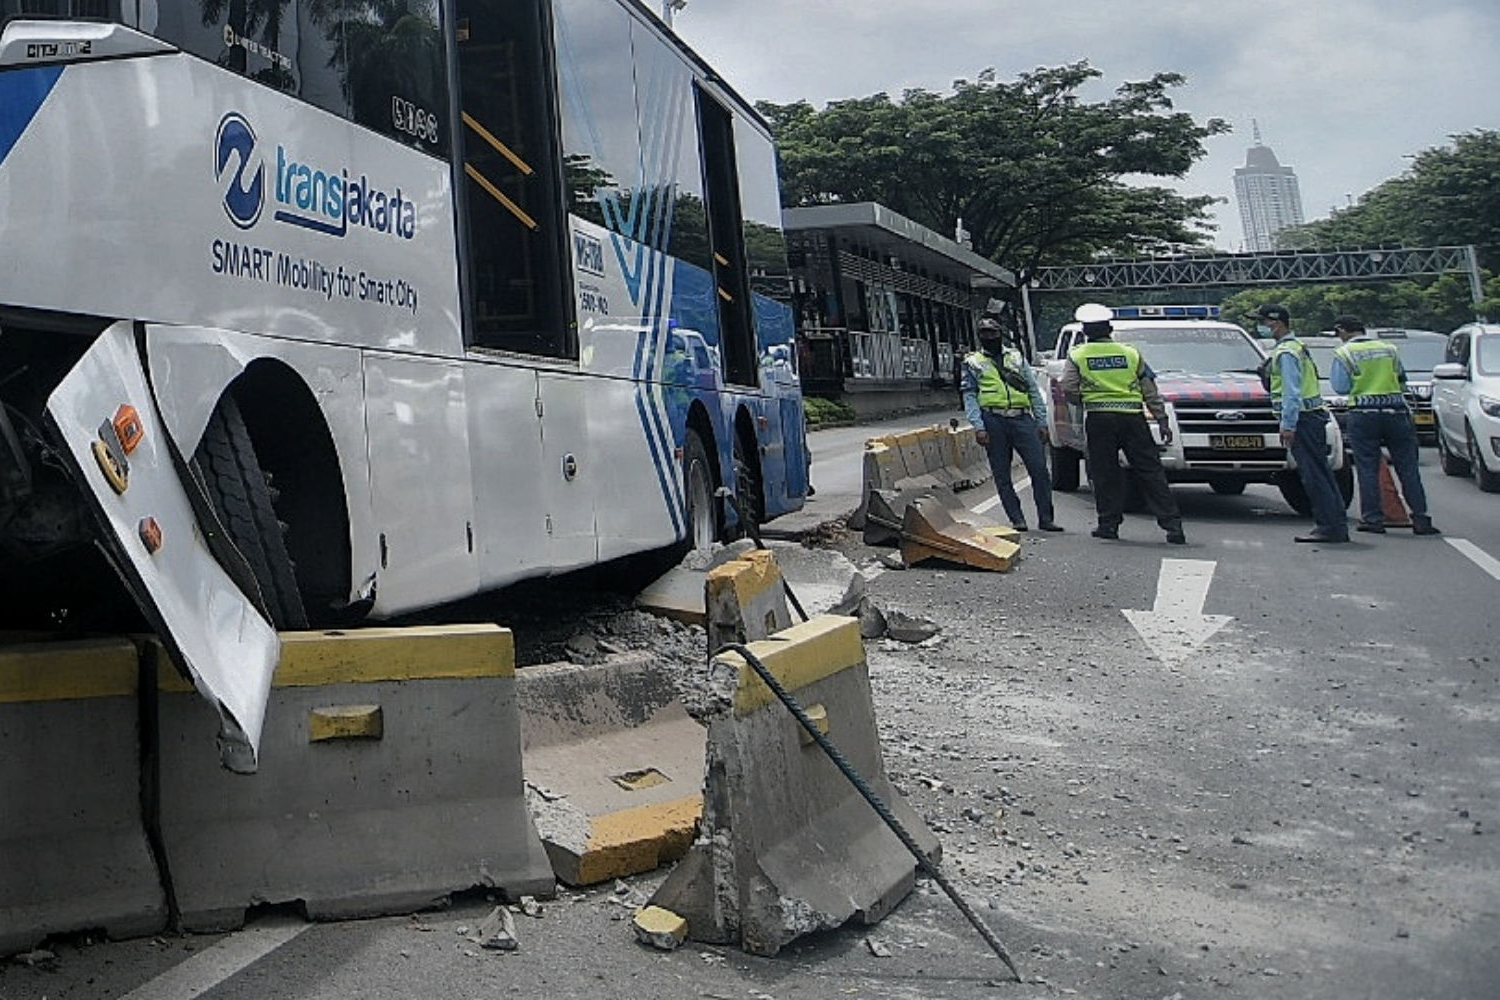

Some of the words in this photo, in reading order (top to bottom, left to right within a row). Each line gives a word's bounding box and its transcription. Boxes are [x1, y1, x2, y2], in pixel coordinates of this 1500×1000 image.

[274, 145, 416, 240] transjakarta
[212, 239, 273, 283] SMART
[277, 253, 334, 300] Mobility
[336, 266, 356, 297] for
[358, 272, 394, 305] Smart
[396, 279, 418, 315] City
[1088, 356, 1128, 369] POLISI
